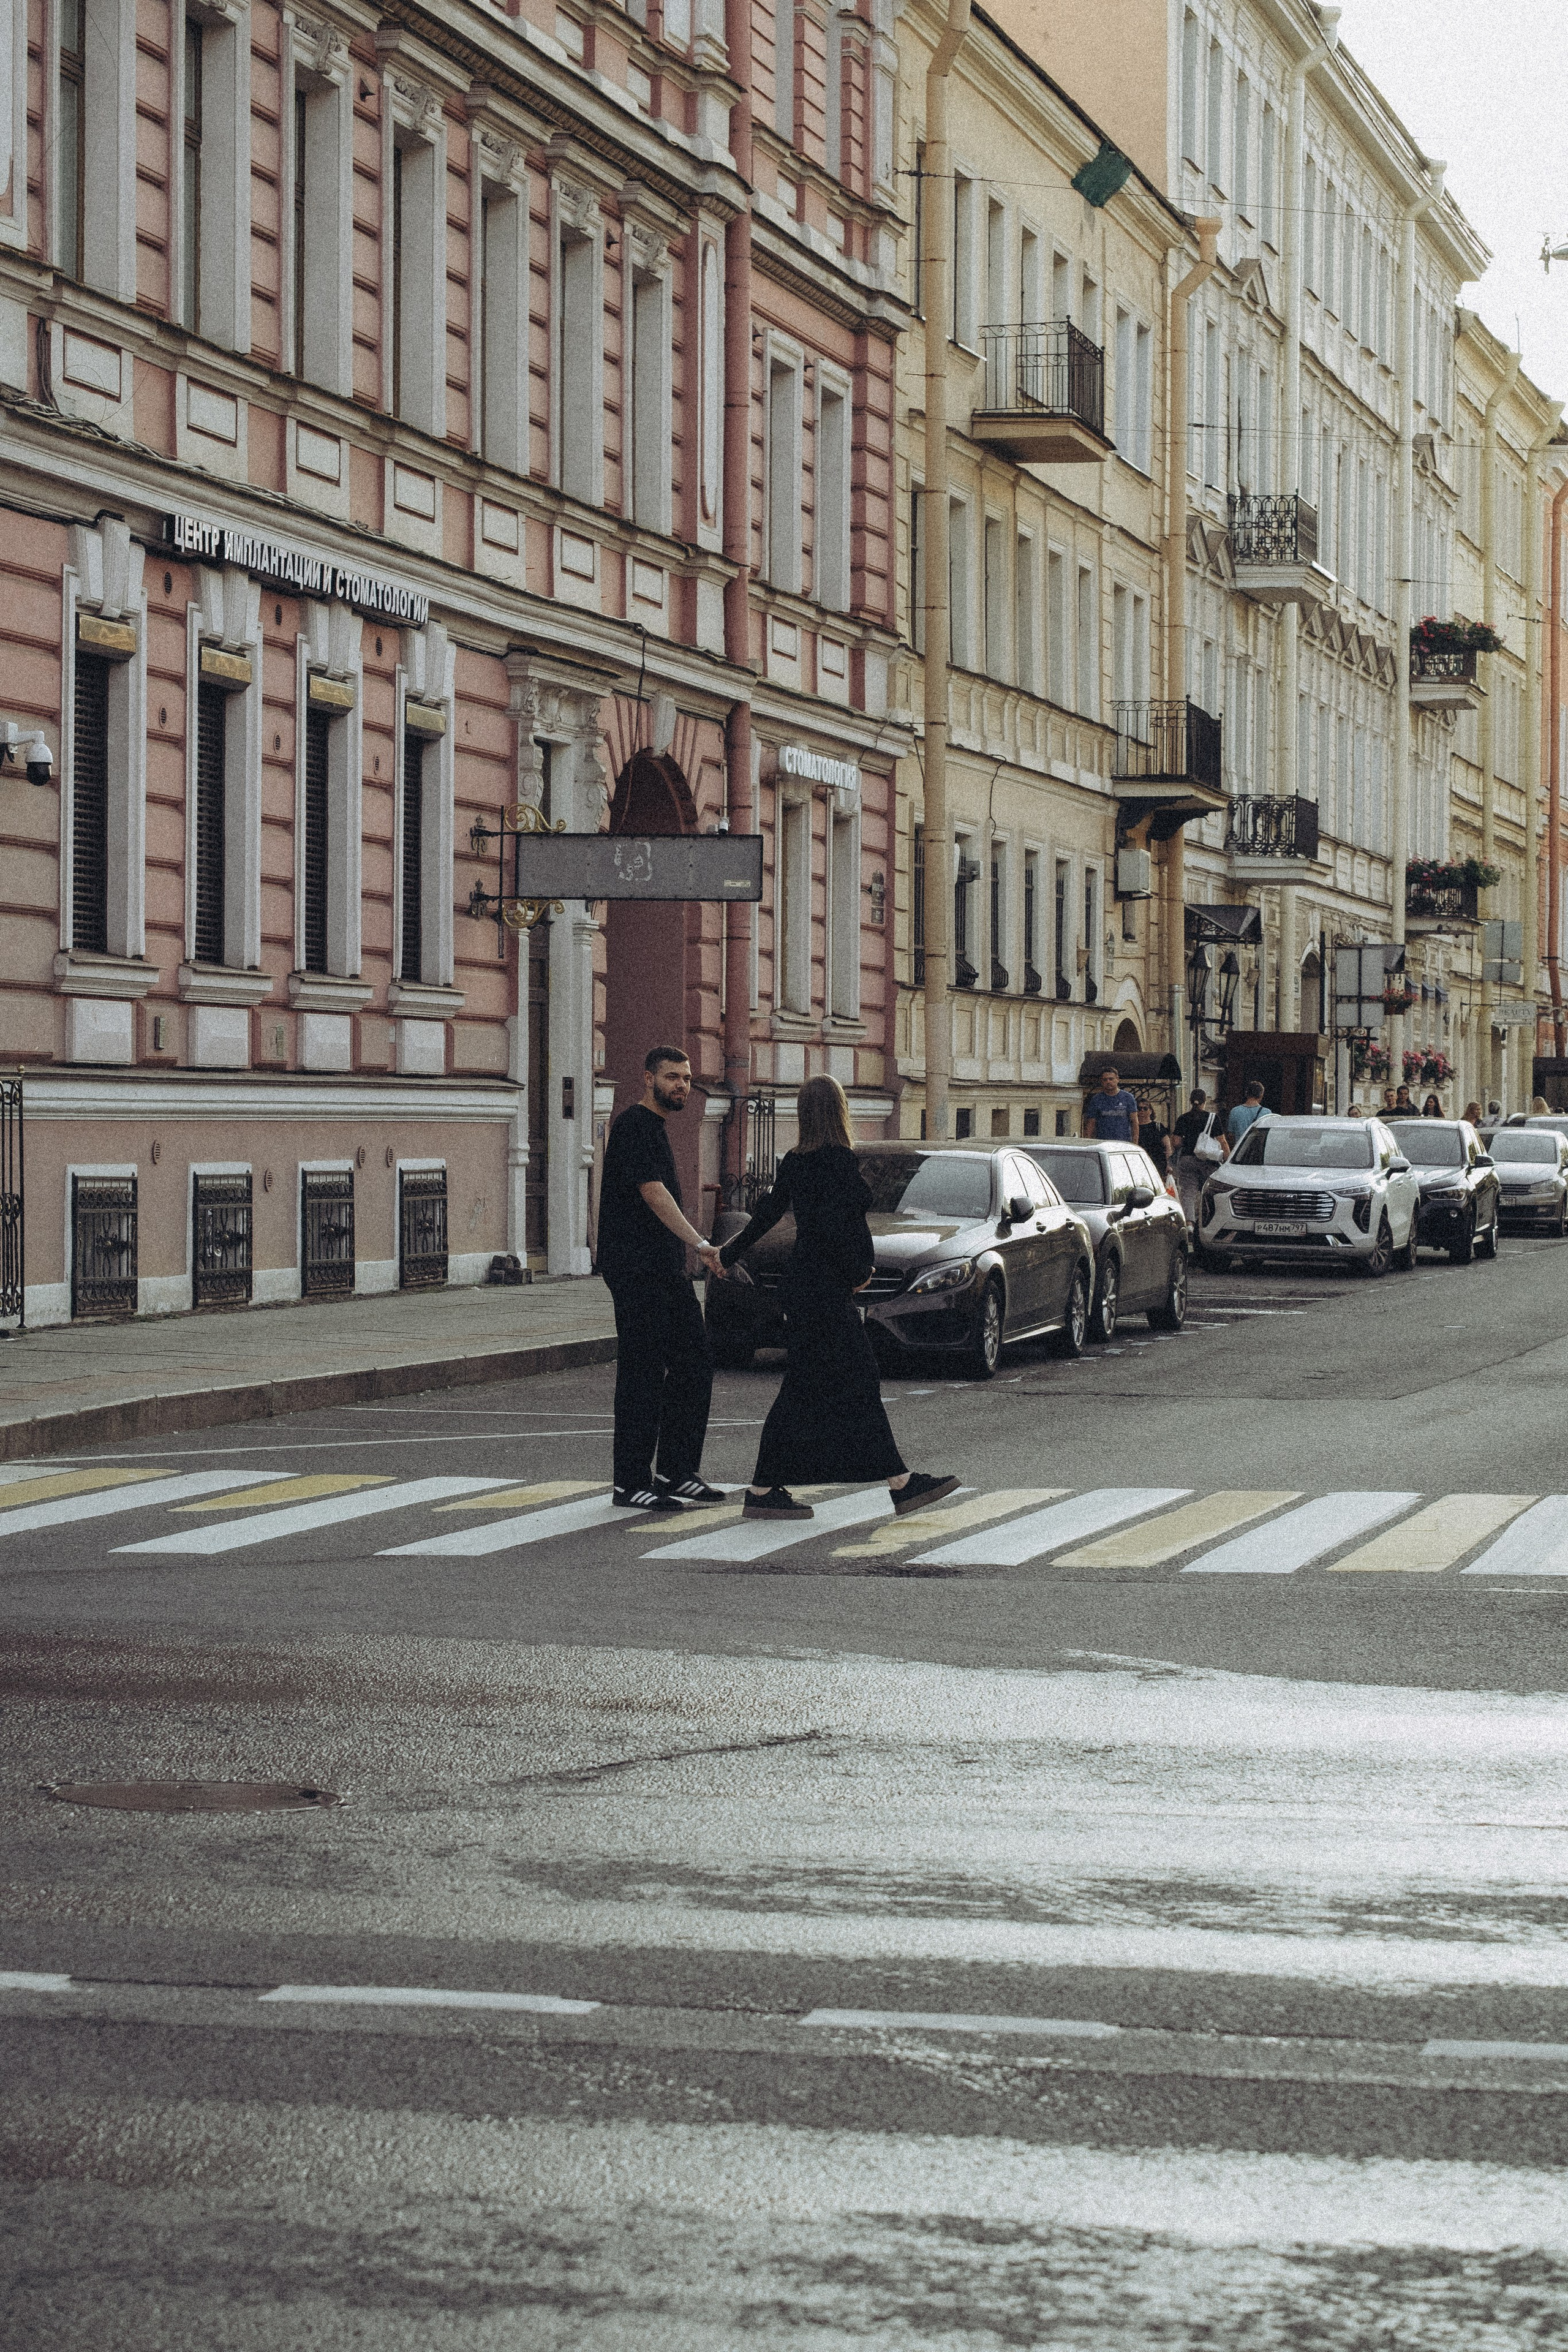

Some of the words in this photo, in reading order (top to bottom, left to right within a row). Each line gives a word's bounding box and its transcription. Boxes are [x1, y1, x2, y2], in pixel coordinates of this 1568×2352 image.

[175, 515, 219, 556] ЦЕНТР
[224, 531, 321, 589] ИМПЛАНТАЦИИ
[323, 565, 332, 593] И
[336, 568, 428, 624] СТОМАТОЛОГИИ
[785, 745, 857, 791] СТОМАТОЛОГИЯ
